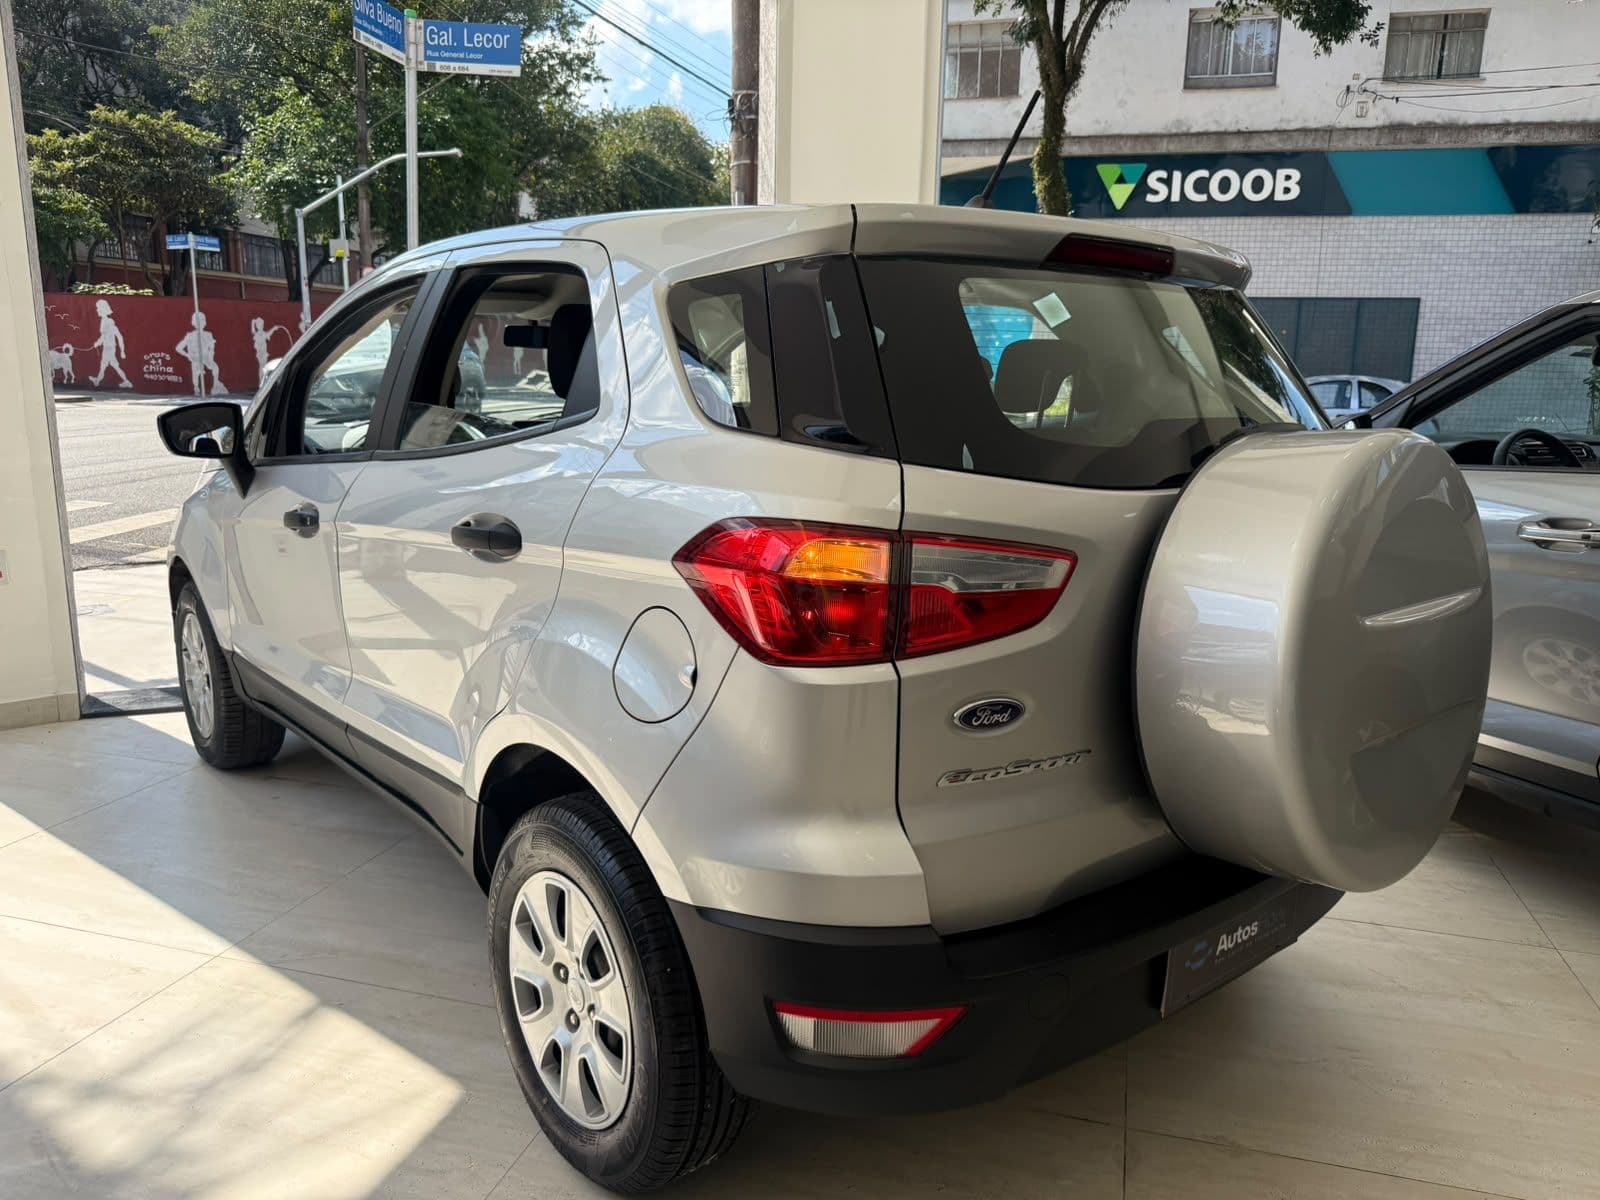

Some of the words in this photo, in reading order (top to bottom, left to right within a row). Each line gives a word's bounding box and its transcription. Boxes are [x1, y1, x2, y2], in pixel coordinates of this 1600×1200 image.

[377, 3, 402, 34] Bueno
[426, 26, 457, 47] Gal.
[463, 28, 511, 49] Lecor
[1145, 168, 1301, 203] SICOOB
[972, 706, 1012, 726] Ford
[1215, 921, 1259, 957] Autos
